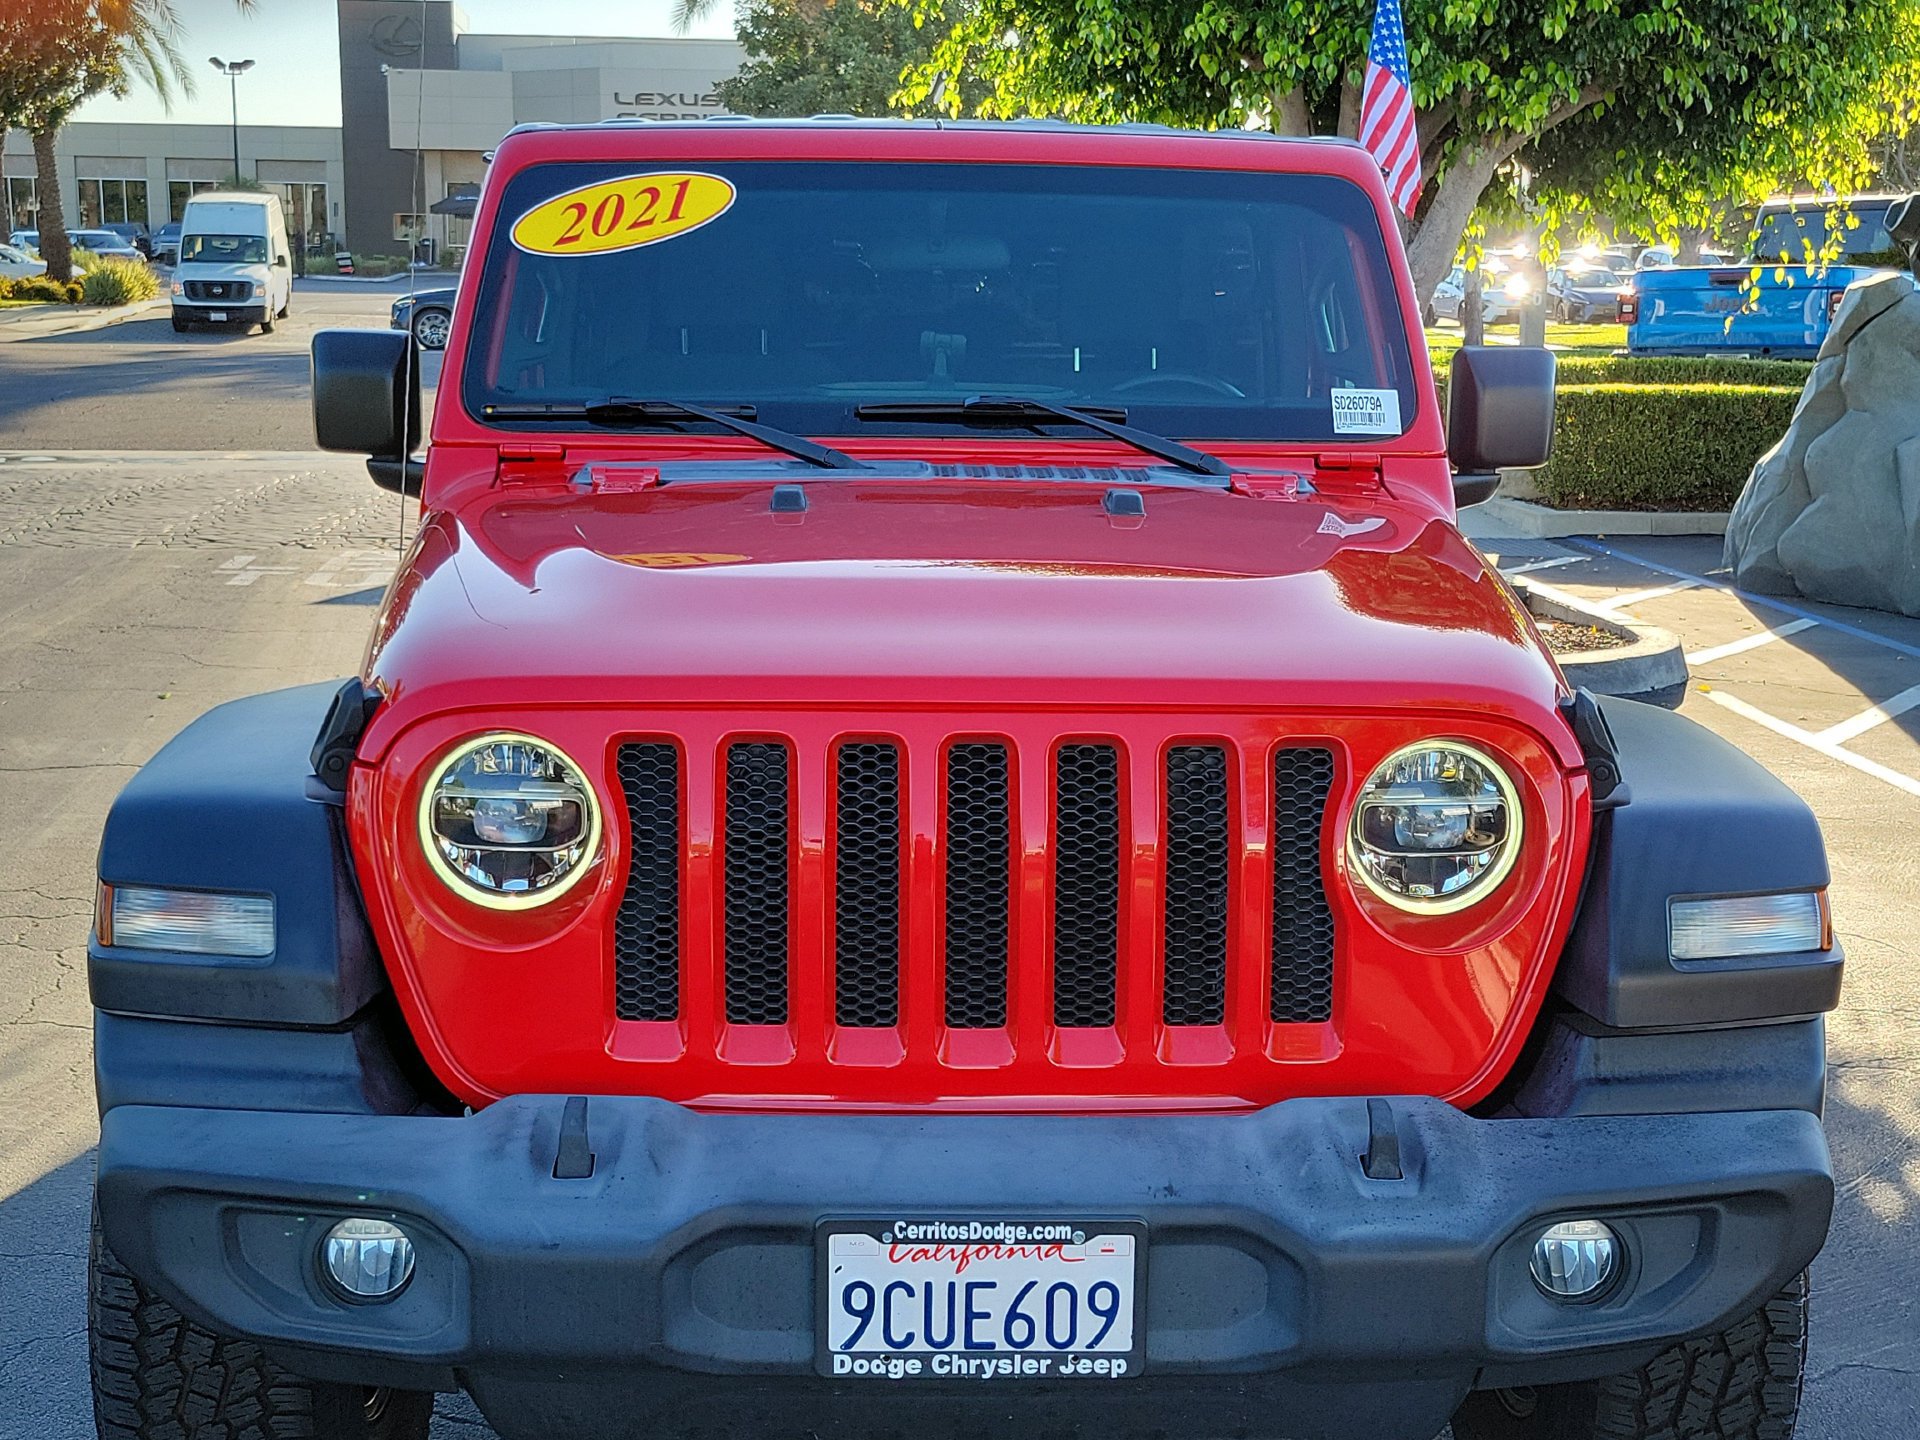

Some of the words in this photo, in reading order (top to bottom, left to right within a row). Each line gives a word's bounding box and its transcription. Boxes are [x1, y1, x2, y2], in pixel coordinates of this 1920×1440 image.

[613, 91, 721, 107] LEXUS
[552, 178, 691, 247] 2021
[1334, 395, 1382, 411] SD26079A
[894, 1221, 1072, 1244] CerritosDodge.com
[888, 1243, 1086, 1275] California
[839, 1280, 1120, 1350] 9CUE609
[833, 1354, 923, 1379] Dodge
[931, 1354, 1051, 1379] Chrysler
[1059, 1354, 1127, 1379] Jeep
